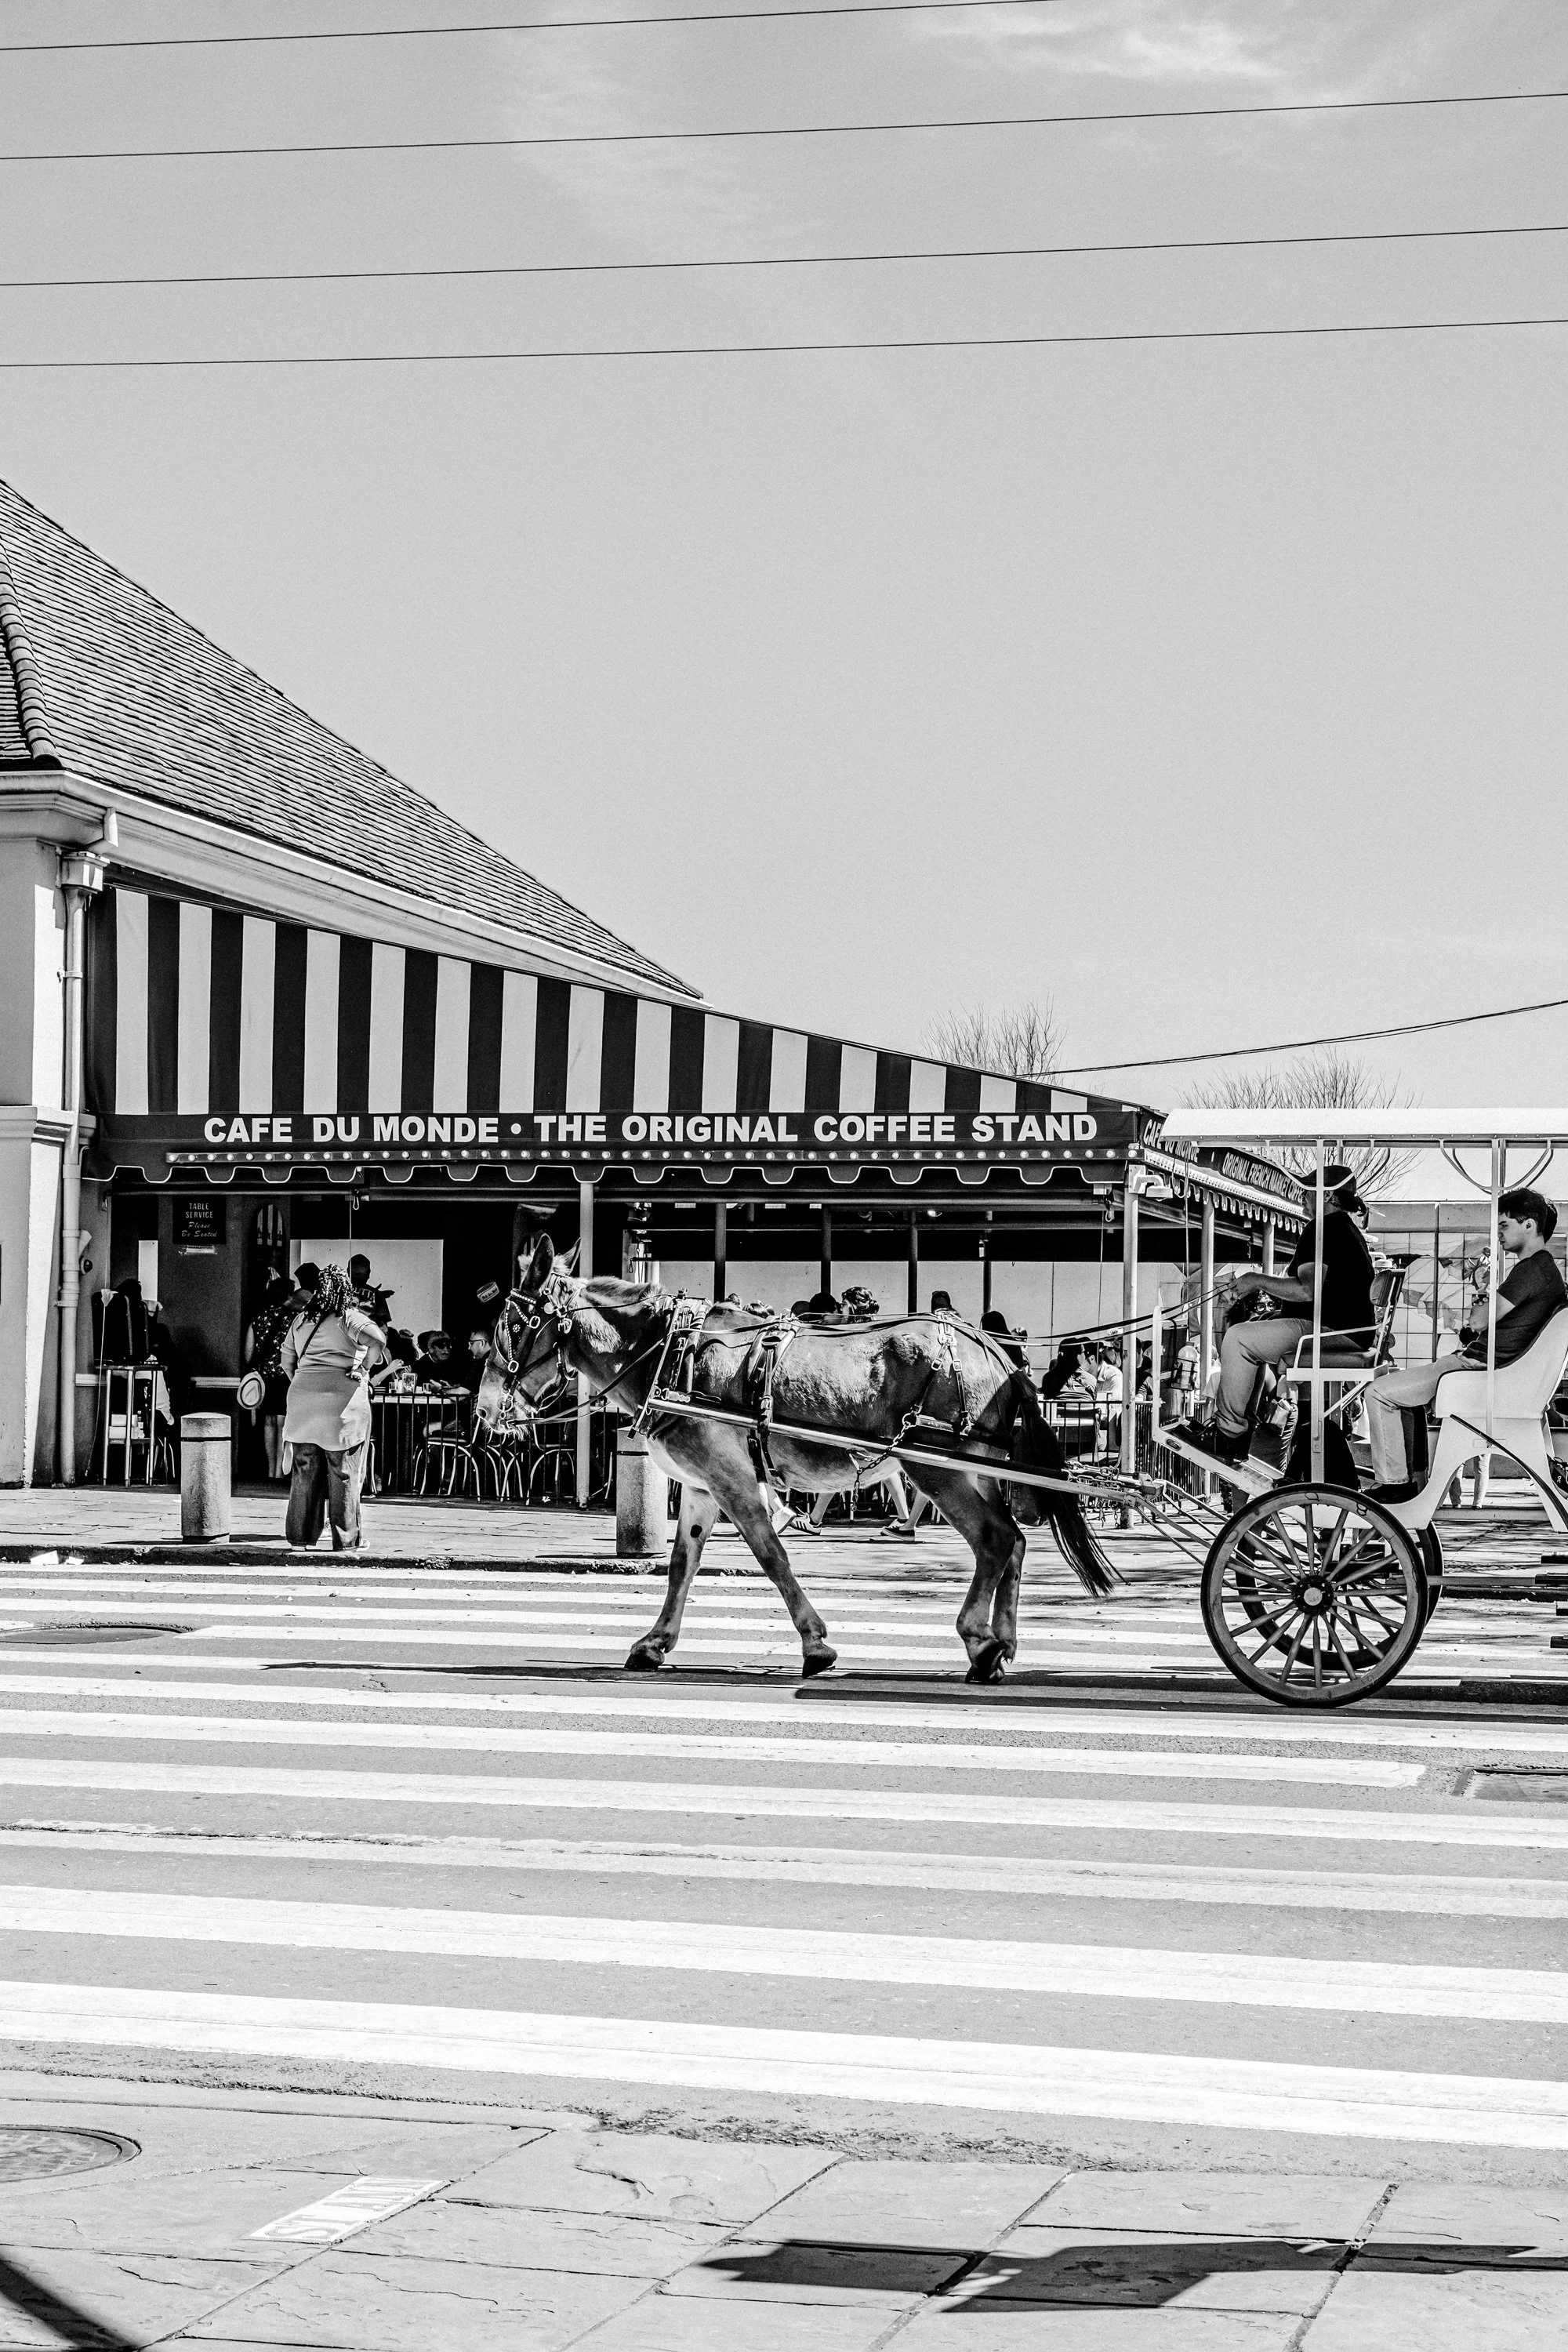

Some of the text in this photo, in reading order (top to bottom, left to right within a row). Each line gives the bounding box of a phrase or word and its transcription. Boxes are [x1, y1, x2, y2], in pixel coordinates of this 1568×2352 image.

[204, 1114, 1098, 1143] CAFE DU MONDE THE ORIGINAL COFFEE STAND
[1222, 1152, 1250, 1182] ORIGINAL
[1247, 1163, 1272, 1189] FRENCH
